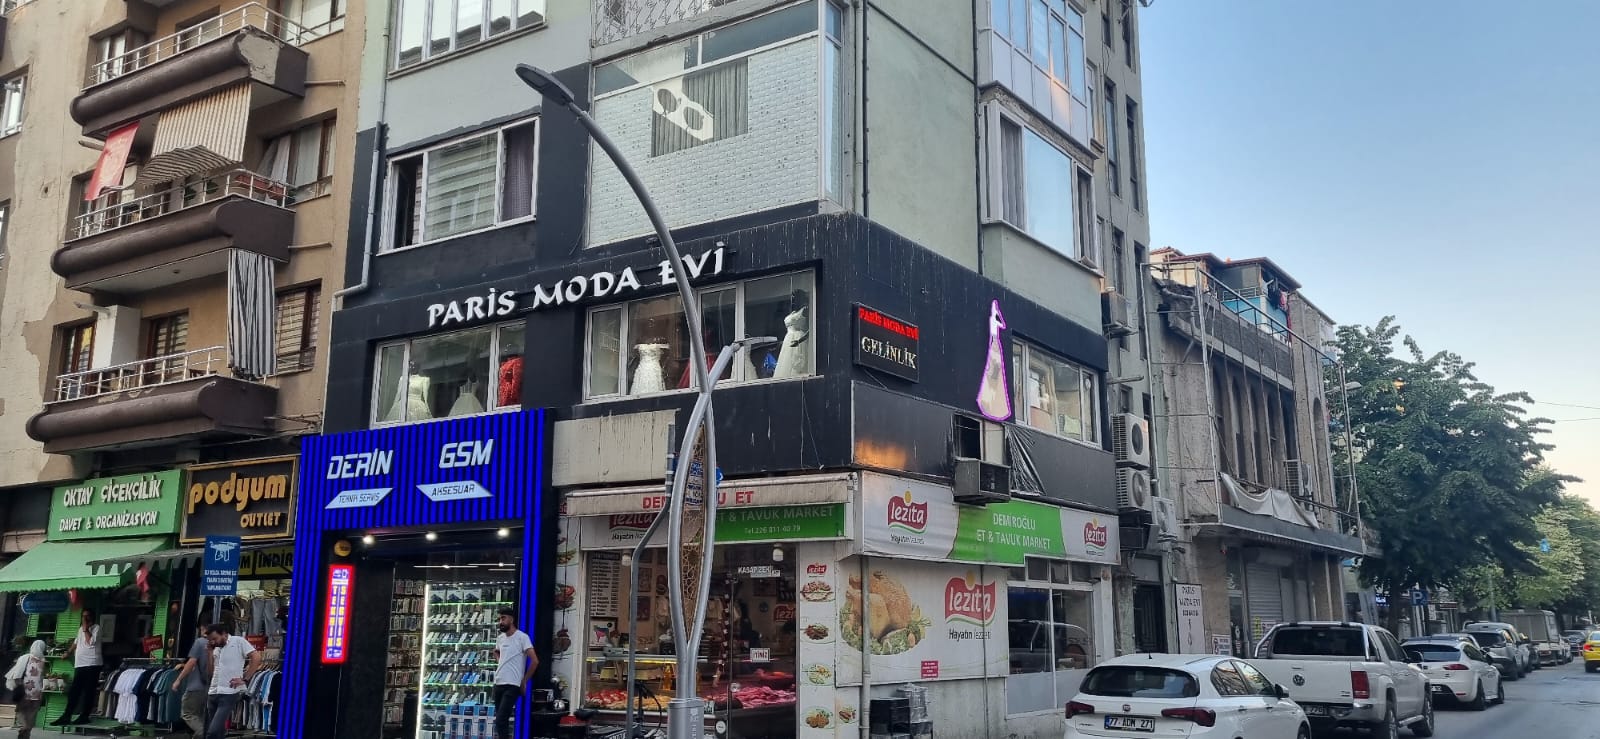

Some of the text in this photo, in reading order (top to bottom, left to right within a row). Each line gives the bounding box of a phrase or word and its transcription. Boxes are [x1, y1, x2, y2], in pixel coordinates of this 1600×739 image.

[427, 241, 725, 328] PARİS MODA EVİ
[861, 336, 917, 369] GELİNLİK
[439, 439, 495, 469] GSM
[63, 475, 163, 507] OKTAY ÇİÇEKÇİLİK
[188, 472, 287, 514] podyum
[431, 483, 475, 497] AKSESUAR
[735, 490, 754, 505] ET
[59, 517, 81, 532] DAVET
[96, 510, 158, 529] ORGANİZASYON
[240, 512, 282, 528] OUTLET
[741, 510, 780, 521] TAVUK
[783, 506, 834, 519] MARKET
[993, 512, 1036, 530] DEMİROĞLU
[977, 529, 1050, 549] ET & TAVUK MARKET
[1412, 591, 1422, 605] P
[1110, 717, 1118, 726] 77
[1140, 719, 1153, 729] 271
